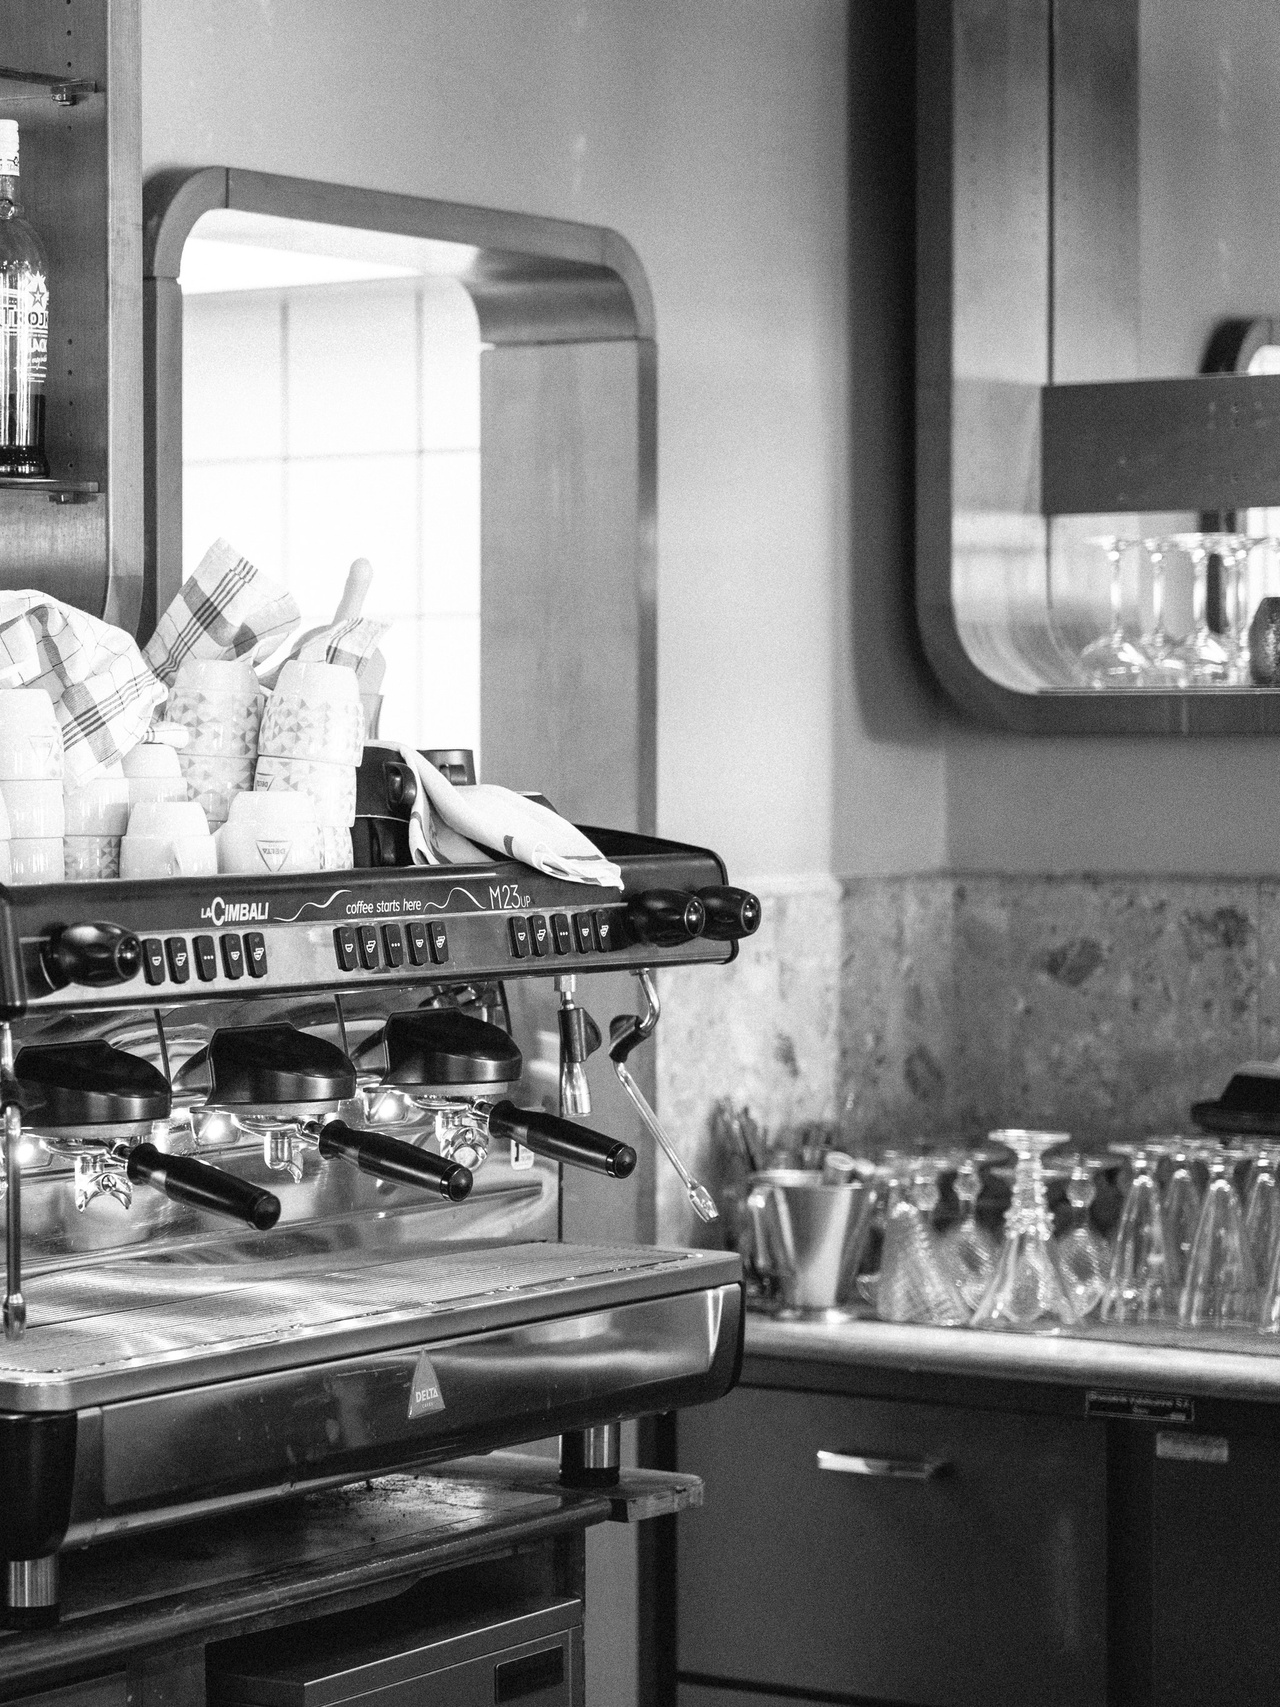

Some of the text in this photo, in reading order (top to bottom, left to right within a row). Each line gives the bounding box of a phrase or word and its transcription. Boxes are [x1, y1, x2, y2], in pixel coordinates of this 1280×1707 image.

[200, 896, 269, 926] LA CIMBALI
[345, 898, 422, 915] coffee starts here
[416, 1387, 438, 1403] DELTA
